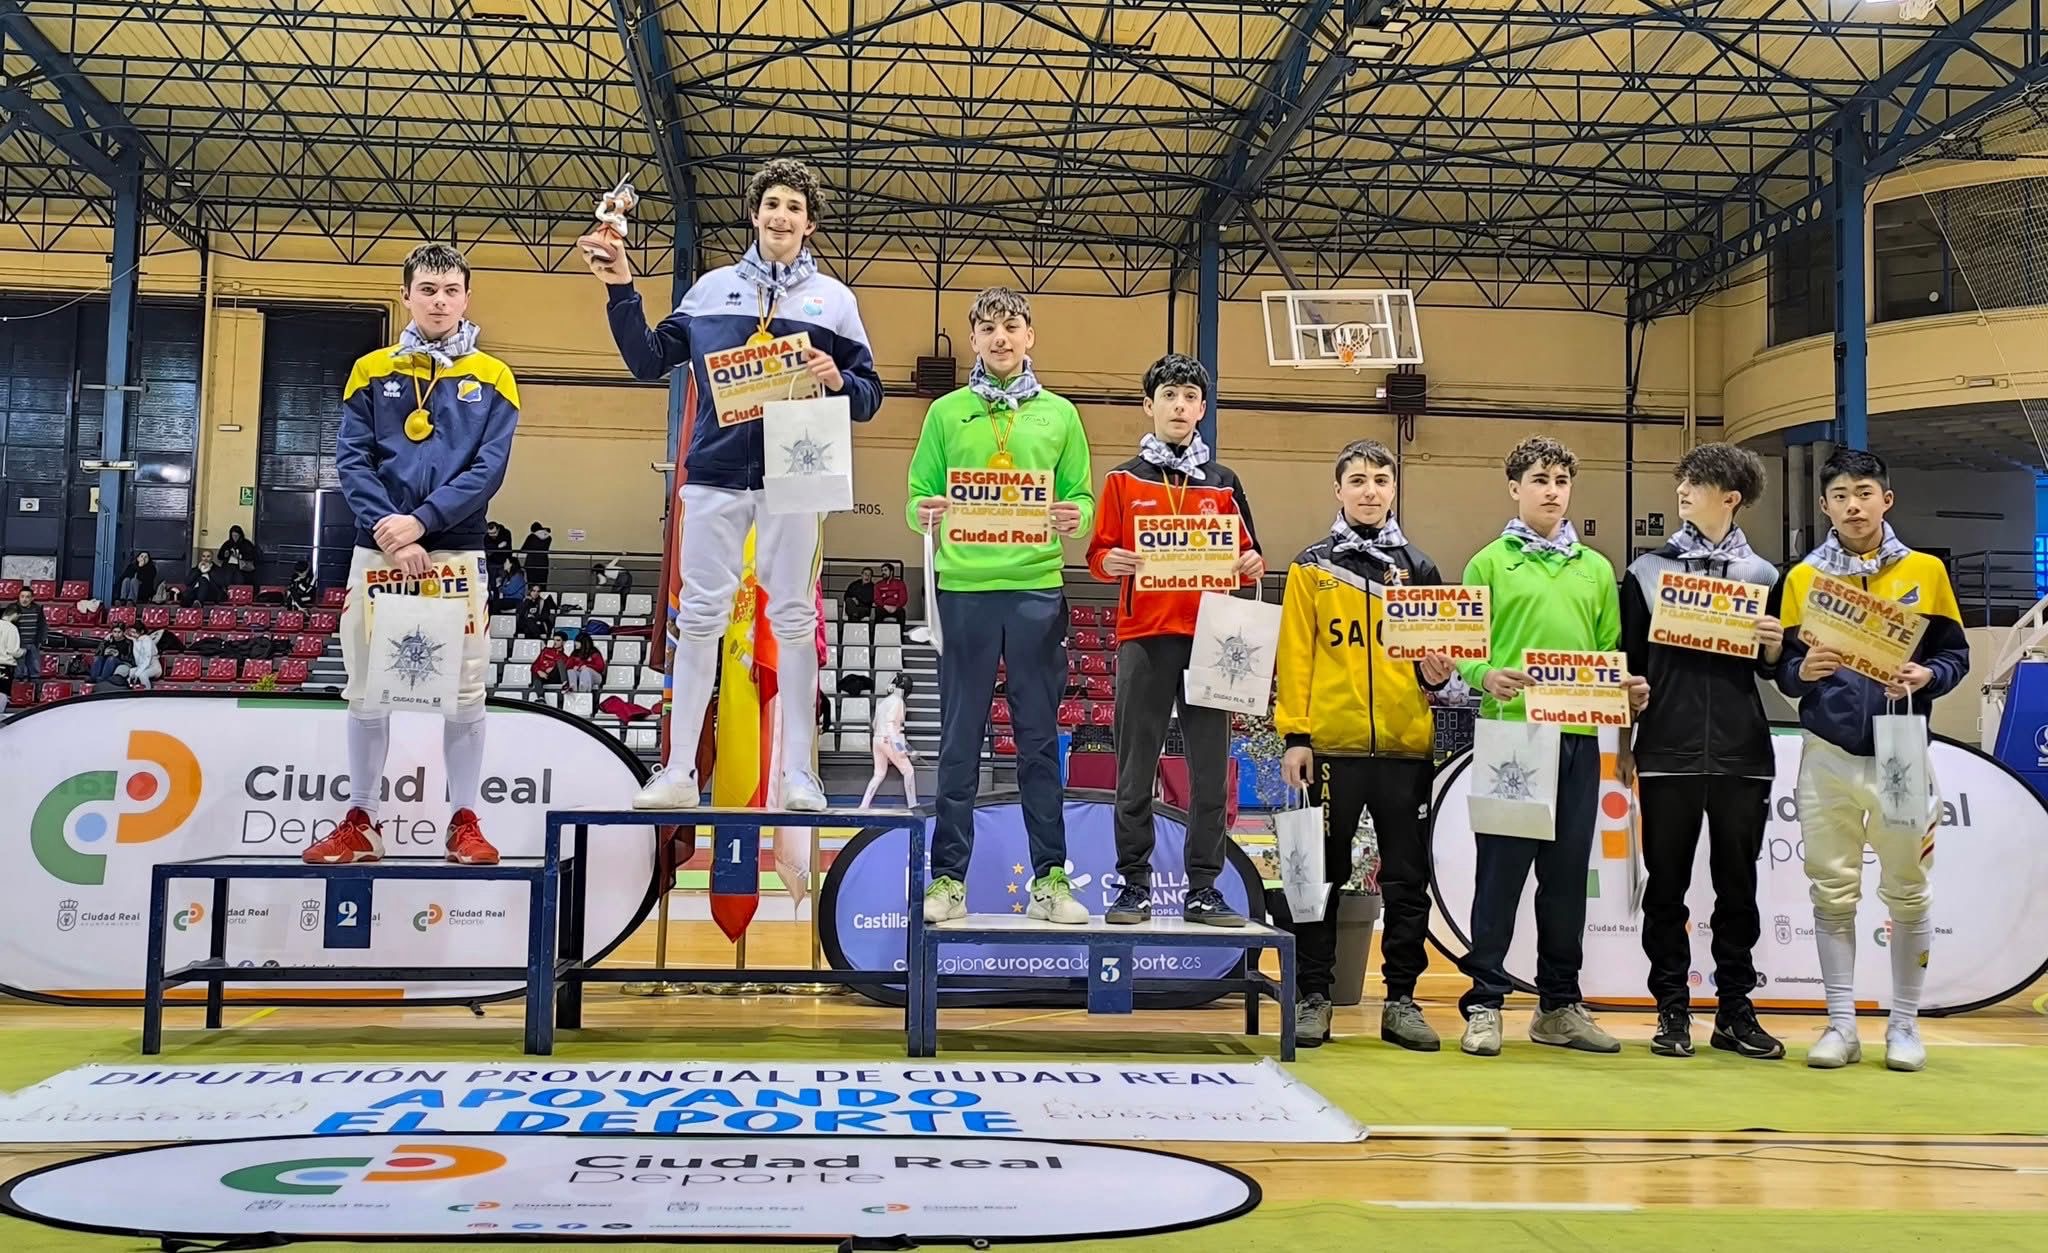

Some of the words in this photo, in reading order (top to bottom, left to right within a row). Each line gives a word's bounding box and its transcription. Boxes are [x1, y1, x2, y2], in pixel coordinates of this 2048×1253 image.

[709, 341, 793, 369] ESGRIMA
[950, 471, 1035, 485] ESGRIMA
[950, 485, 1047, 502] QUIJOTE
[1138, 518, 1221, 531] ESGRIMA
[949, 529, 1008, 543] Ciudad
[1011, 530, 1048, 544] Real
[1139, 531, 1234, 548] QUIJOTE
[1140, 575, 1198, 588] Ciudad
[1201, 574, 1236, 588] Real
[1662, 573, 1748, 598] ESGRIMA
[1386, 589, 1471, 601] ESGRIMA
[1661, 586, 1760, 615] QUIJOTE
[1387, 602, 1484, 618] QUIJOTE
[1653, 628, 1714, 649] Ciudad
[1716, 638, 1755, 656] Real
[1450, 645, 1487, 658] Real
[1526, 652, 1608, 667] ESGRIMA
[1527, 666, 1622, 683] QUIJOTE
[1530, 708, 1588, 723] Ciudad
[1590, 711, 1627, 725] Real
[446, 767, 553, 804] eal
[241, 809, 437, 846] Deprte
[728, 838, 742, 864] 1
[80, 911, 116, 922] Ciudad
[118, 912, 141, 921] Real
[249, 908, 270, 917] Real
[336, 900, 359, 927] 2
[449, 909, 483, 918] Ciudad
[485, 910, 506, 918] Real
[1587, 924, 1617, 932] Ciudad
[1619, 925, 1639, 933] Real
[1934, 927, 1954, 935] Real
[1100, 956, 1121, 983] 3
[90, 1067, 449, 1086] DIPUTACIÓN
[464, 1069, 795, 1083] PROVINCIAL
[816, 1069, 883, 1083] DE
[903, 1069, 1102, 1084] CIUDAD
[1119, 1071, 1256, 1086] REAL
[368, 1087, 982, 1110] APOYANDO
[311, 1111, 447, 1134] EL
[493, 1109, 1025, 1133] DEPORTE
[574, 1154, 862, 1169] Ciudad
[893, 1155, 1063, 1169] Real
[568, 1170, 886, 1187] Deporte
